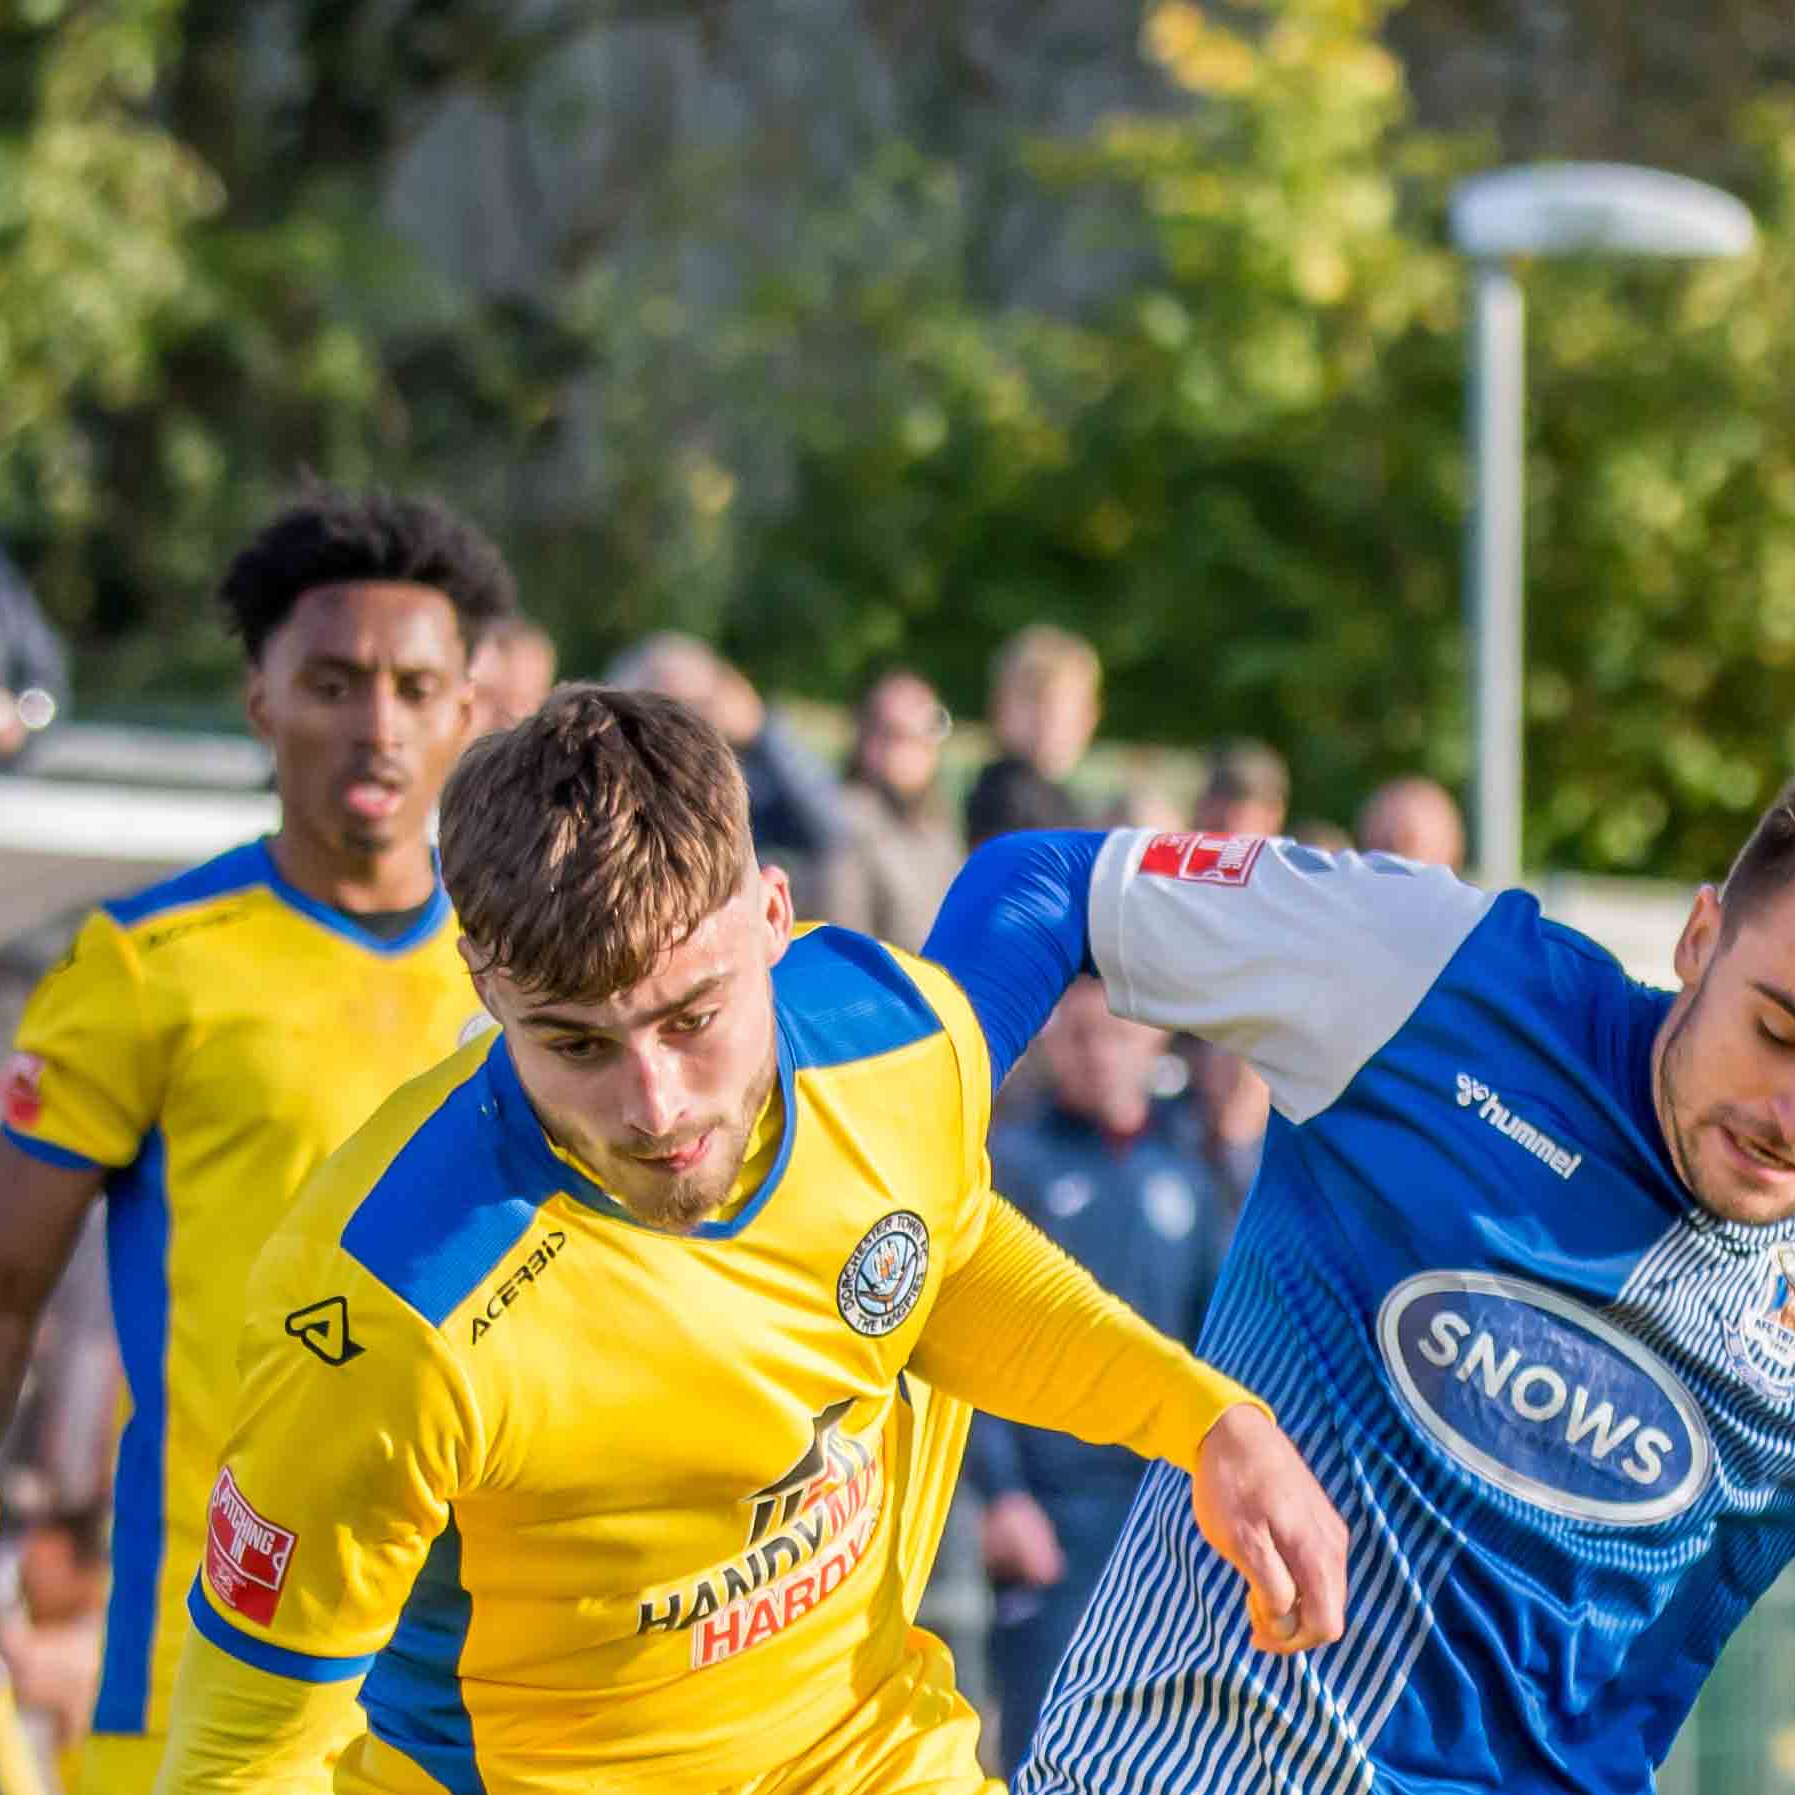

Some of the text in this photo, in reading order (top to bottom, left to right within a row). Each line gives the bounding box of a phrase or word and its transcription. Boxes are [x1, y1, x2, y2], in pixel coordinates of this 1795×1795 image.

[1478, 1091, 1582, 1180] hummel
[472, 1231, 566, 1345] ACERBIS
[841, 1216, 893, 1312] DORCHESTER
[897, 1214, 924, 1236] TOWN
[857, 1272, 926, 1332] THE MAGPIES
[1417, 1310, 1673, 1486] SNOWS
[219, 1485, 277, 1556] PITCHING
